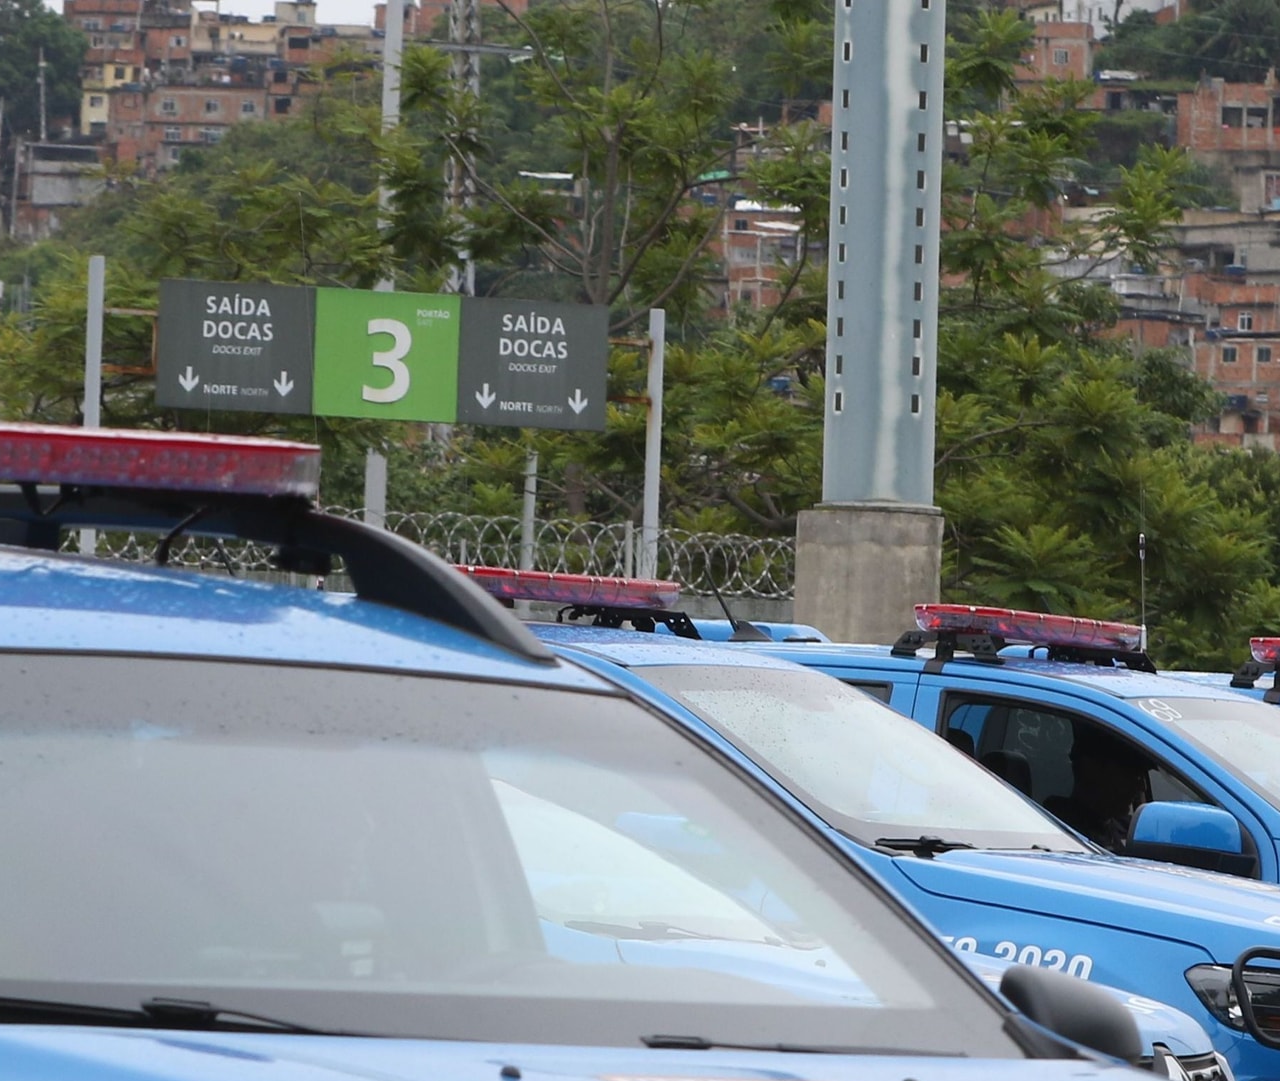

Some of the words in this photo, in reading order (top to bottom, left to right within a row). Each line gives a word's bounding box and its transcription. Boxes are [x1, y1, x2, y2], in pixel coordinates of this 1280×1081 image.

[206, 293, 271, 317] SAÍDA
[416, 308, 450, 319] PORTÃO
[202, 320, 274, 341] DOCAS
[502, 311, 566, 335] SAÍDA
[212, 345, 241, 355] DOCKS
[243, 346, 263, 356] EXIT
[499, 337, 568, 359] DOCAS
[362, 318, 412, 403] 3
[508, 362, 537, 373] DOCKS
[538, 364, 558, 374] EXIT
[203, 384, 238, 395] NORTE
[240, 387, 269, 396] NORTH
[500, 401, 533, 412] NORTE
[535, 405, 563, 414] NORTH
